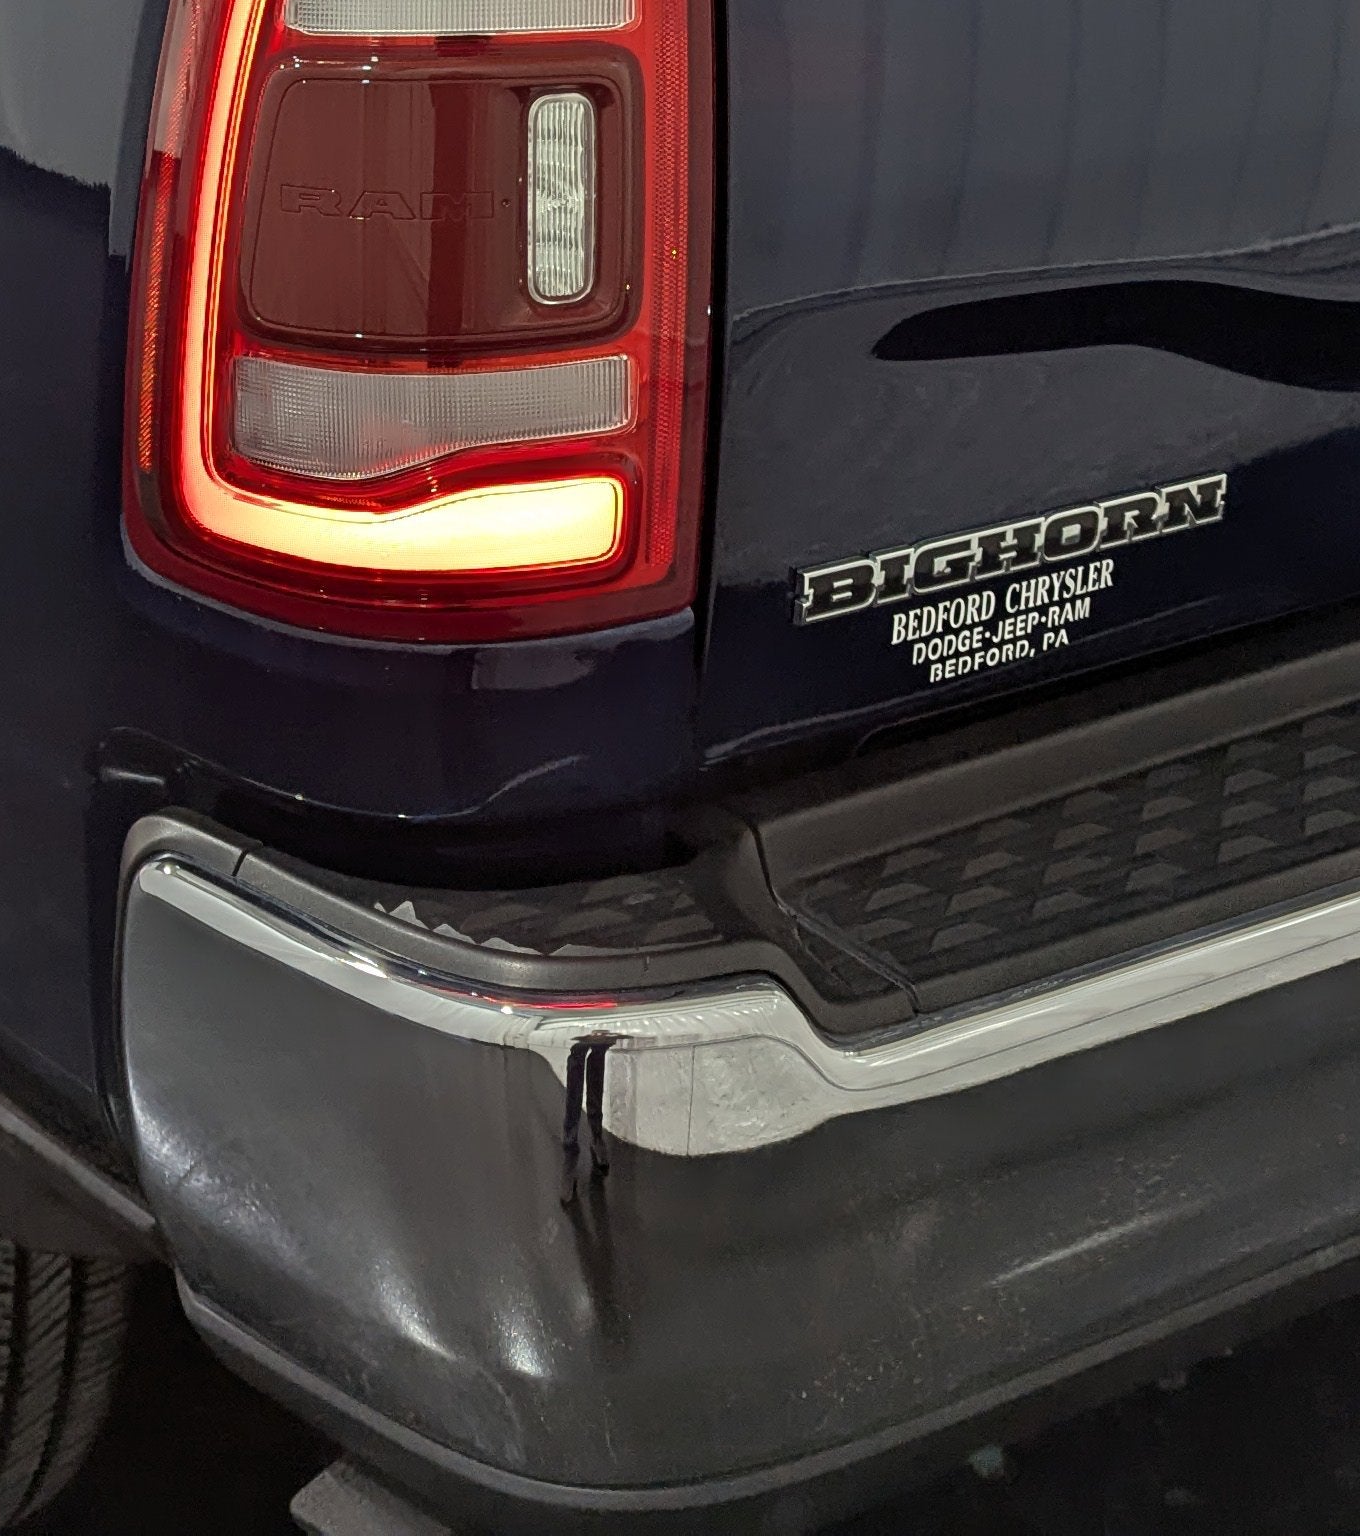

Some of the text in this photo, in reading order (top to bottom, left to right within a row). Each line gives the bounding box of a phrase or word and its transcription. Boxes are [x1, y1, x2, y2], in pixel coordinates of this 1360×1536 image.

[280, 183, 494, 220] RAM
[890, 558, 1115, 646] BEDFORD CHRYSLER
[929, 628, 1070, 683] BEDFORD, PA
